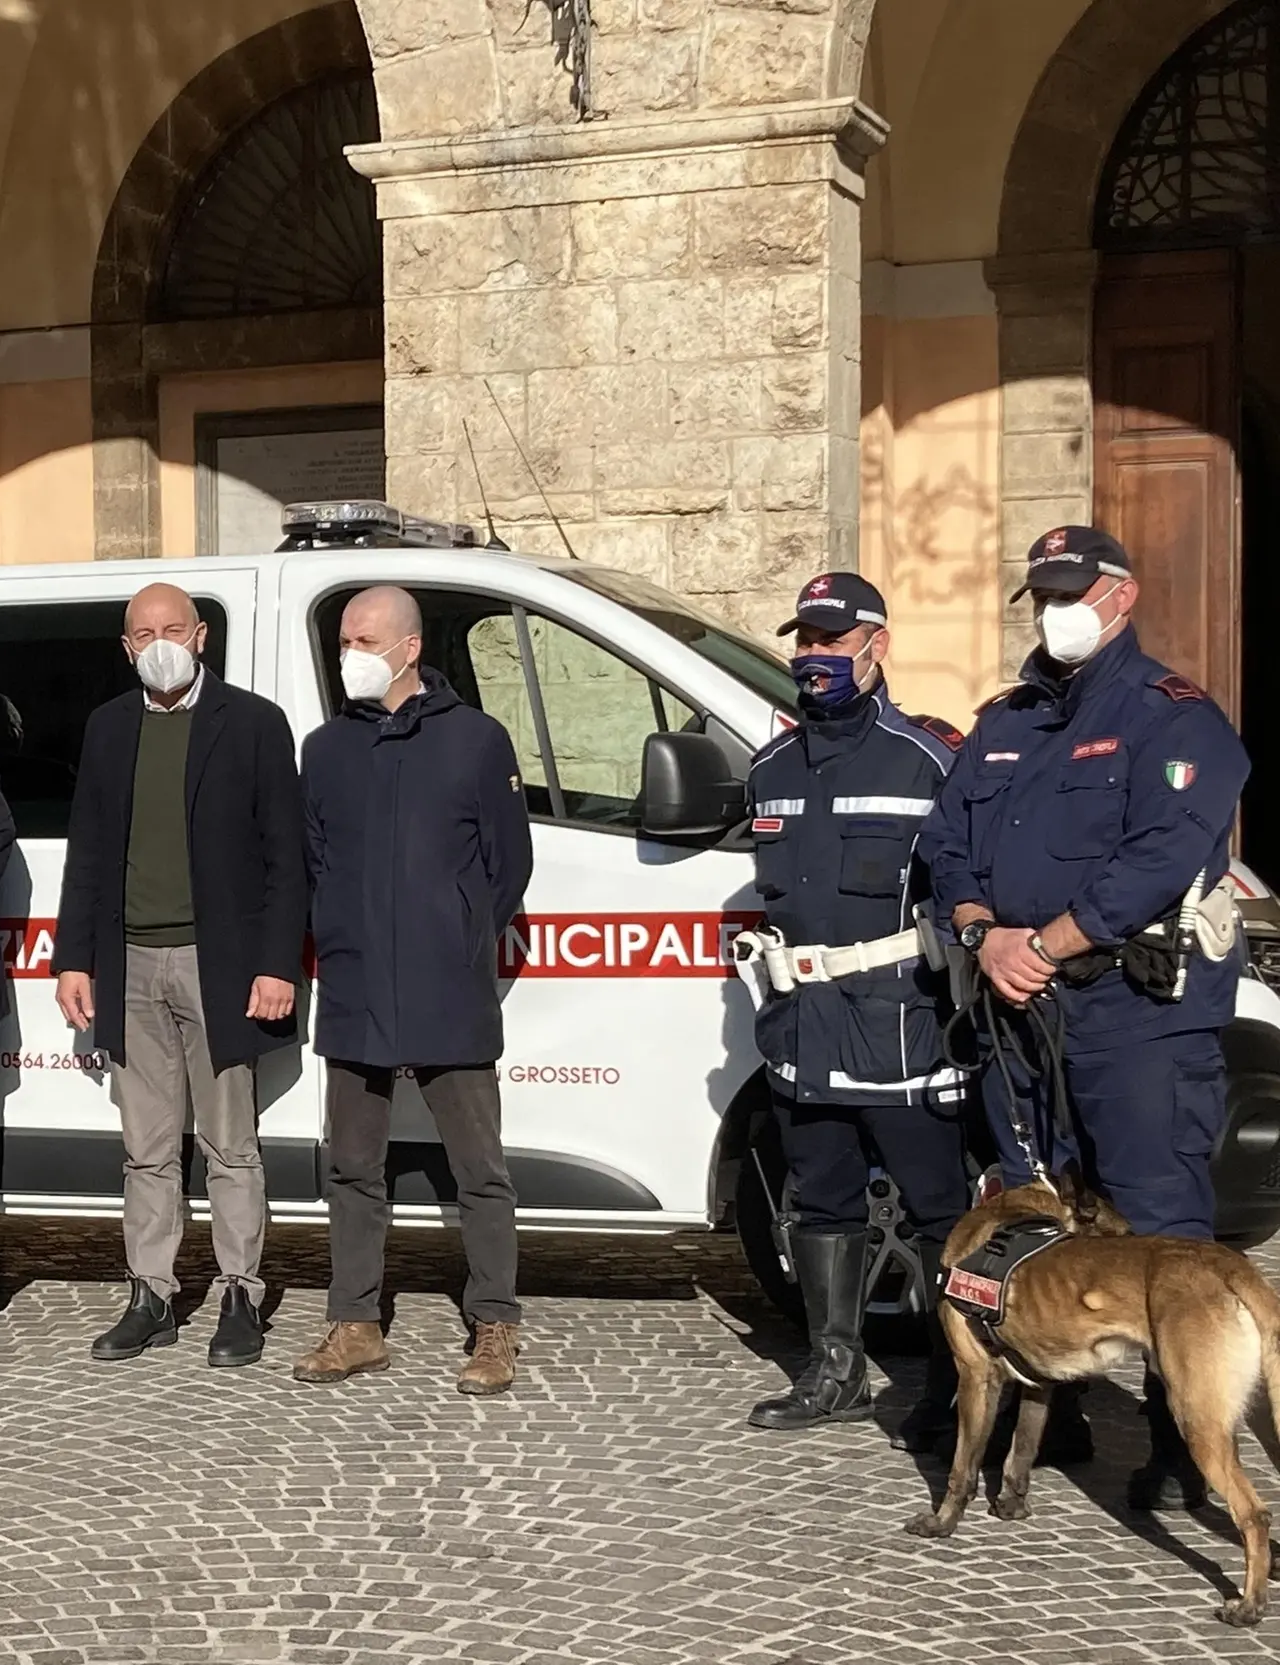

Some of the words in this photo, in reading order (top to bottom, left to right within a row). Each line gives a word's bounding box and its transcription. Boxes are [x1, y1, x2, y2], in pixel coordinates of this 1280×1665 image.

[504, 922, 744, 968] NICIPALE
[0, 1051, 106, 1071] 0564.26000
[508, 1065, 621, 1085] GROSSETO
